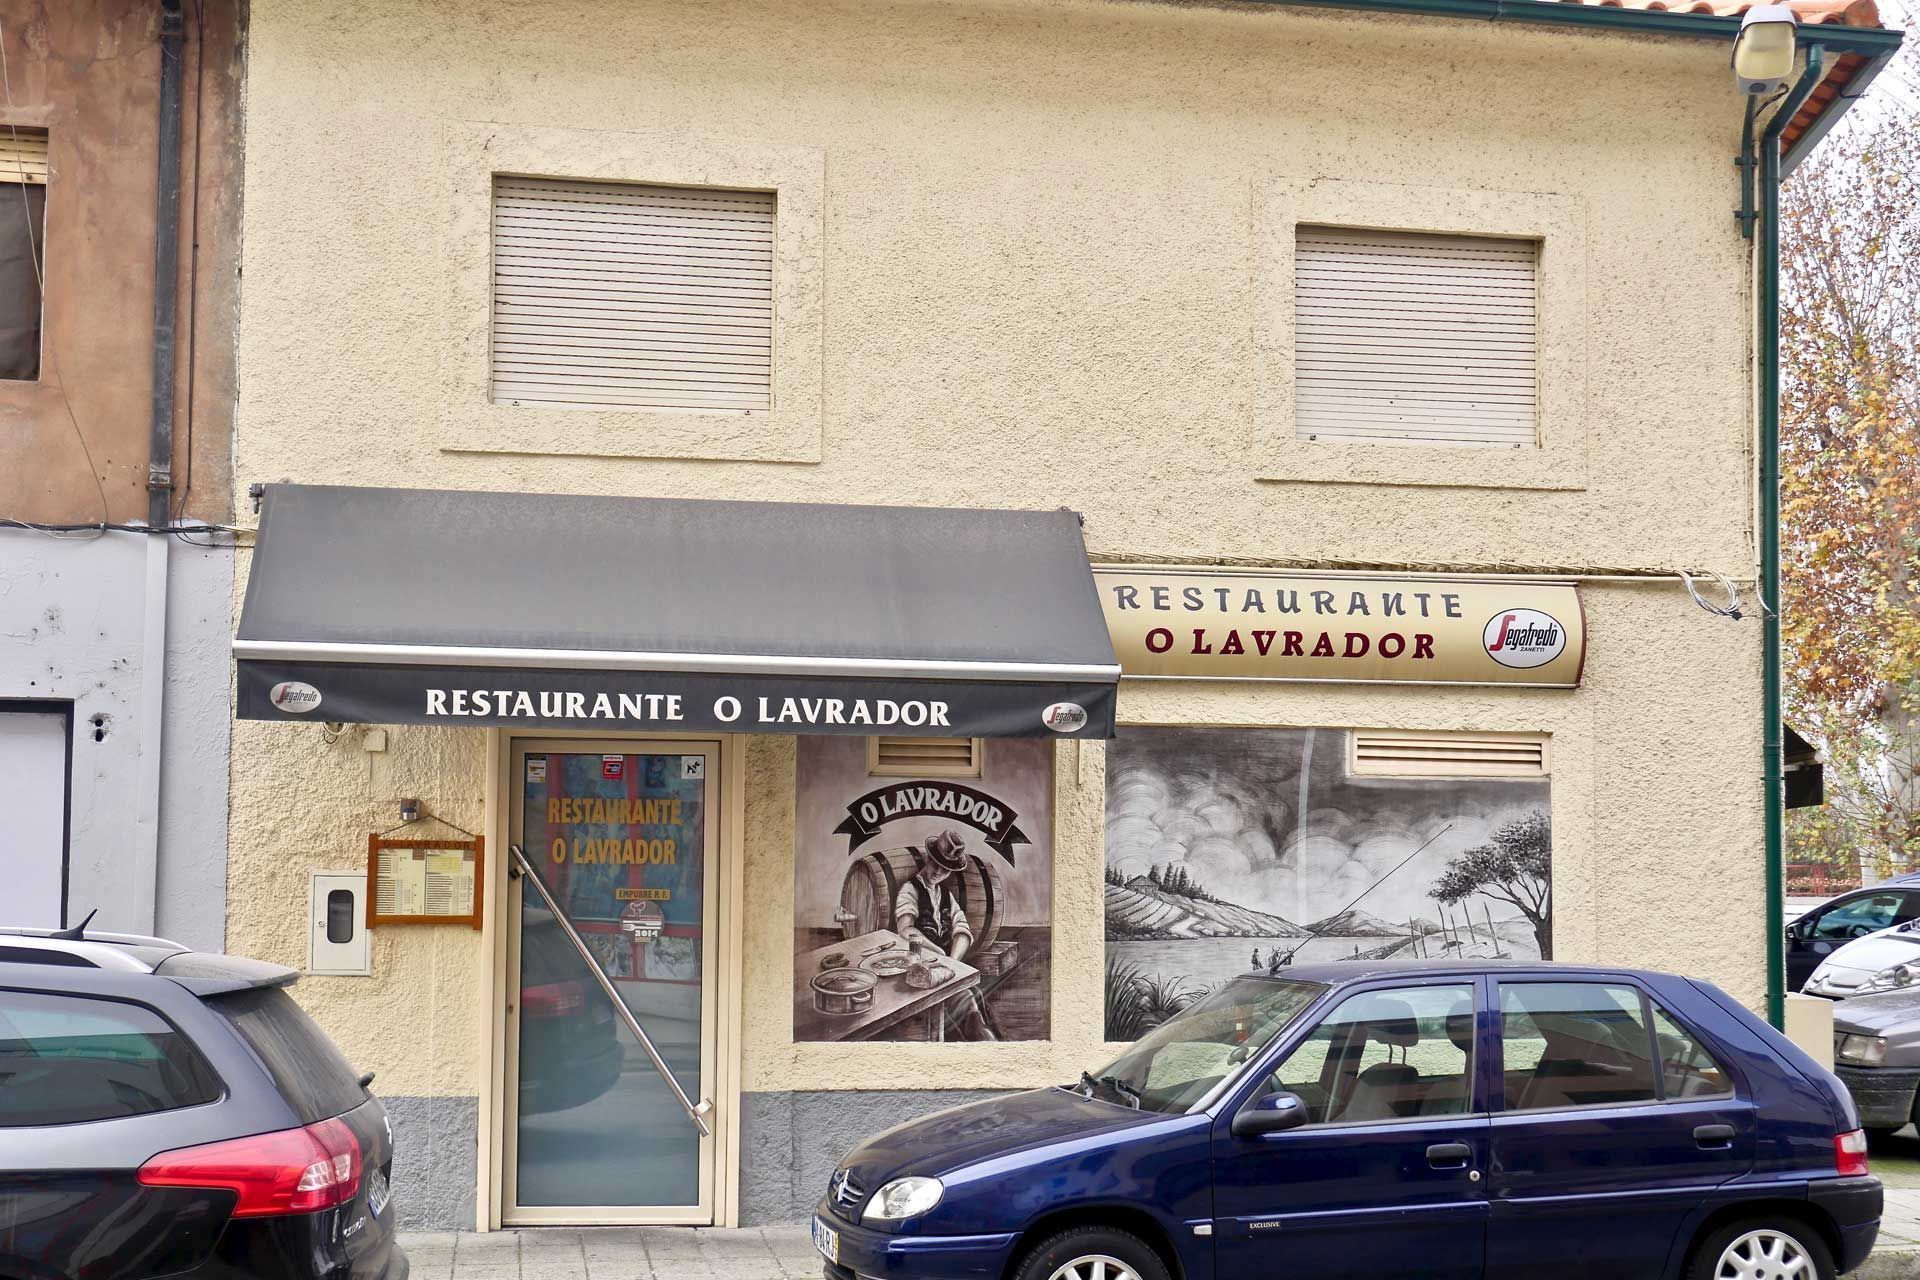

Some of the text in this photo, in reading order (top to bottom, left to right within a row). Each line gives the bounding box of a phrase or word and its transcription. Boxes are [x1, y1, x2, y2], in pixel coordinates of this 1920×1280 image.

[1112, 585, 1463, 618] RESTAURANTE
[1145, 627, 1435, 659] O LAVRADOR
[1488, 614, 1558, 652] Segafredo
[425, 688, 952, 727] RESTAURANTE O LAVRADOR
[548, 798, 684, 826] RESTAURANTE
[860, 786, 1004, 832] O LAVRADOR
[552, 837, 677, 865] O LAVRADOR
[634, 929, 658, 937] 2014
[1249, 1221, 1281, 1229] EXCLUSIVE
